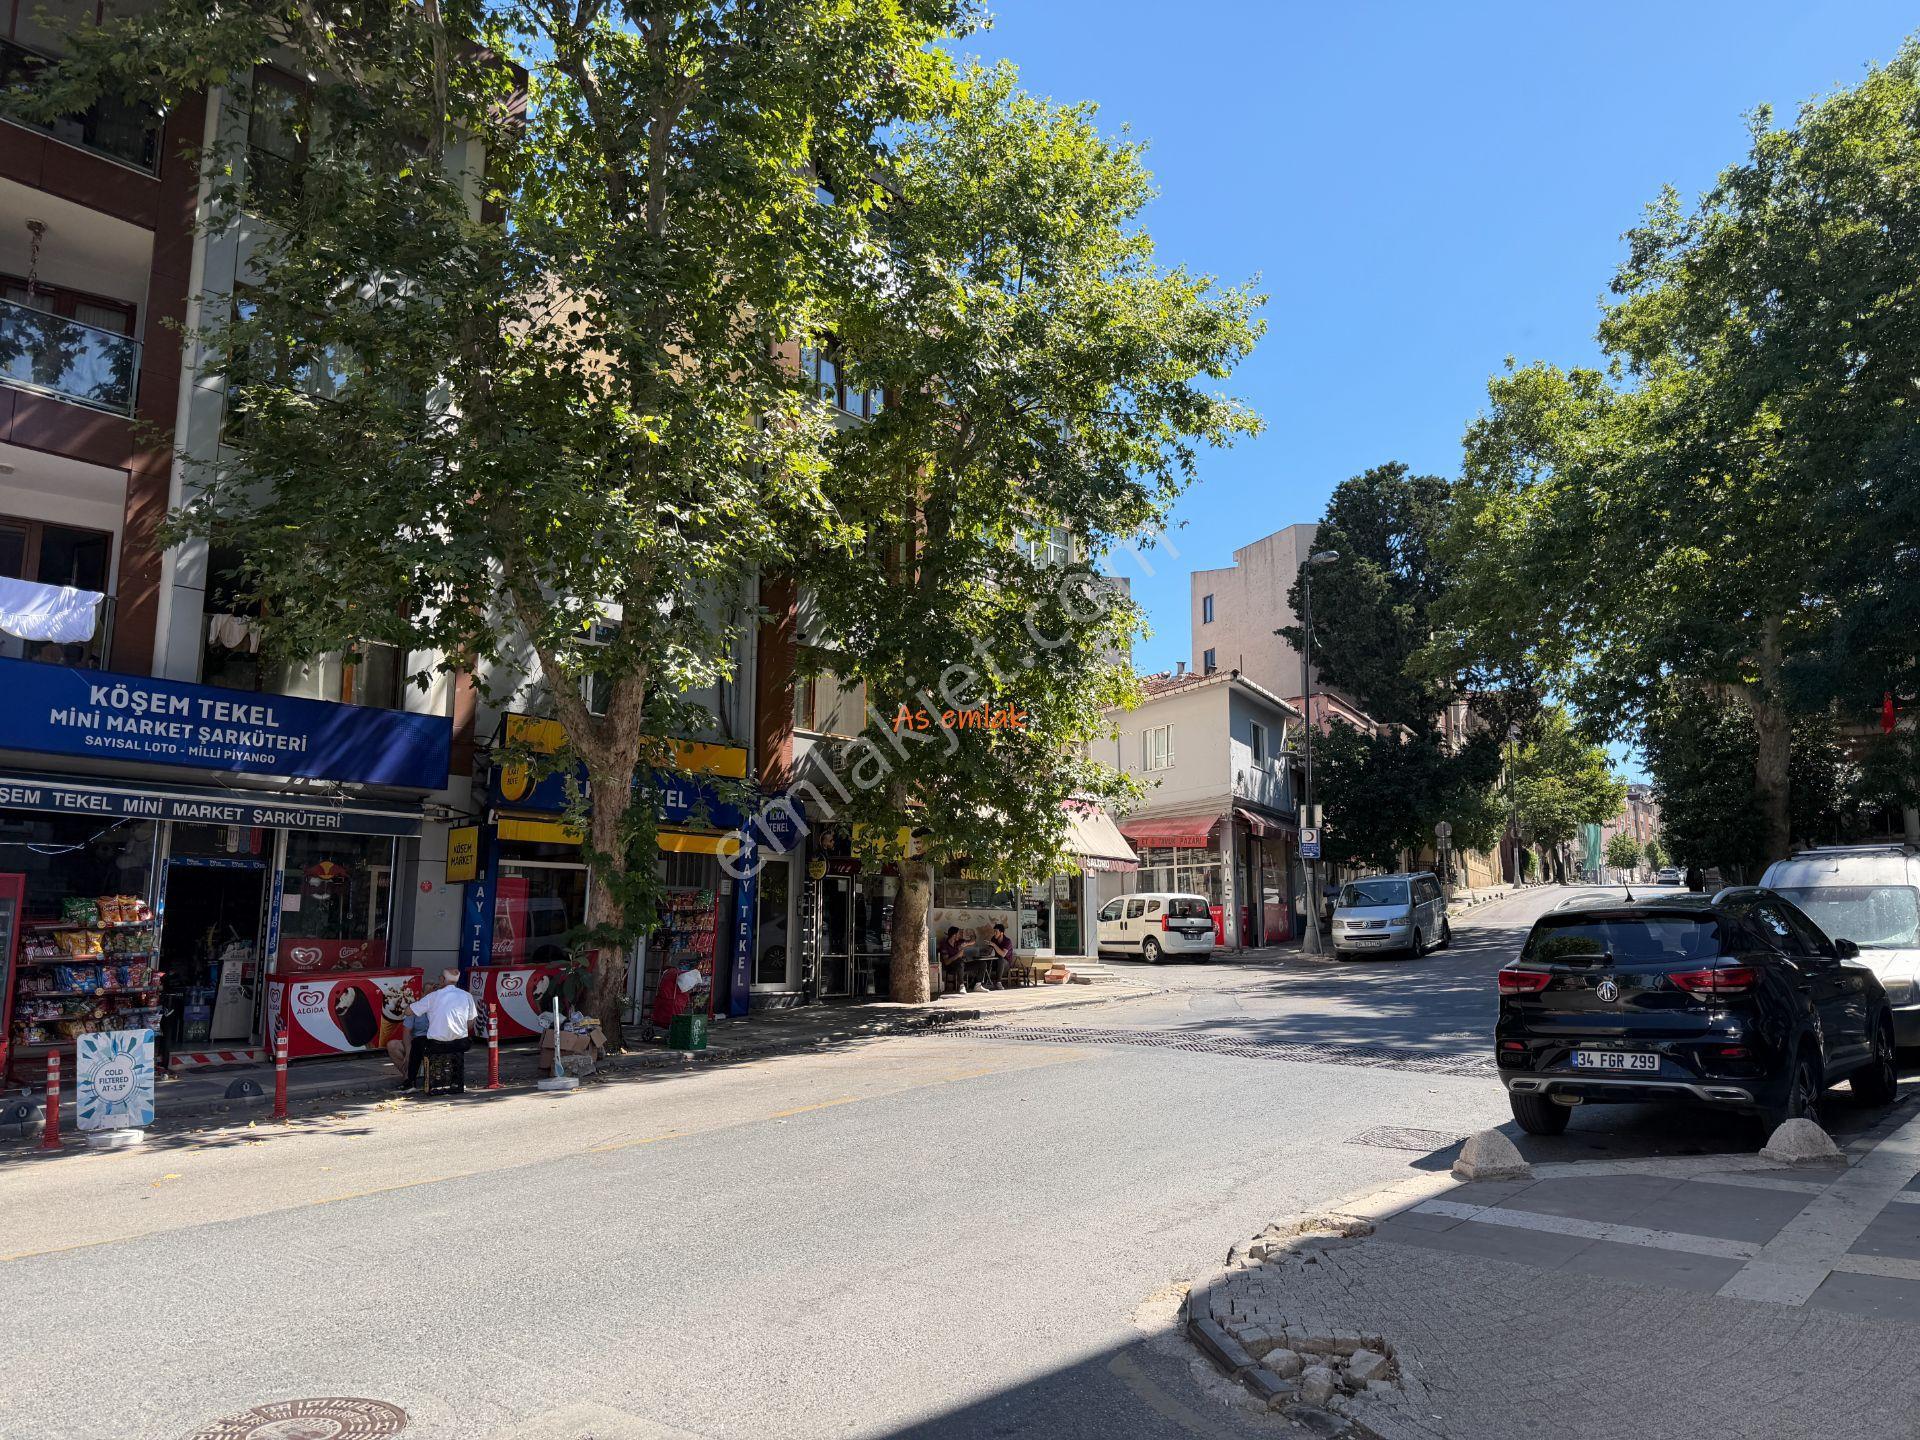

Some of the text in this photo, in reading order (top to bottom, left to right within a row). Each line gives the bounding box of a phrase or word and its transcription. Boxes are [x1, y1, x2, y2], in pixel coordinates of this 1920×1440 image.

[90, 684, 279, 728] KÖŞEM TEKEL
[50, 707, 308, 752] MİNİ MARKET ŞARKÜTERİ
[85, 735, 141, 750] SAYISAL
[145, 742, 177, 754] LOTO
[189, 746, 221, 759] MİLLİ
[224, 750, 276, 764] PİYANGO
[52, 792, 112, 811] TEKEL
[123, 796, 163, 815] MİNİ
[173, 801, 244, 821] MARKET
[252, 808, 341, 829] ŞARKÜTERİ
[450, 854, 473, 866] MARKET
[737, 905, 749, 987] TEKEL
[297, 1007, 324, 1015] ALGIDA
[1578, 1053, 1656, 1069] 34 FGR 299
[99, 1076, 129, 1085] FILTERED
